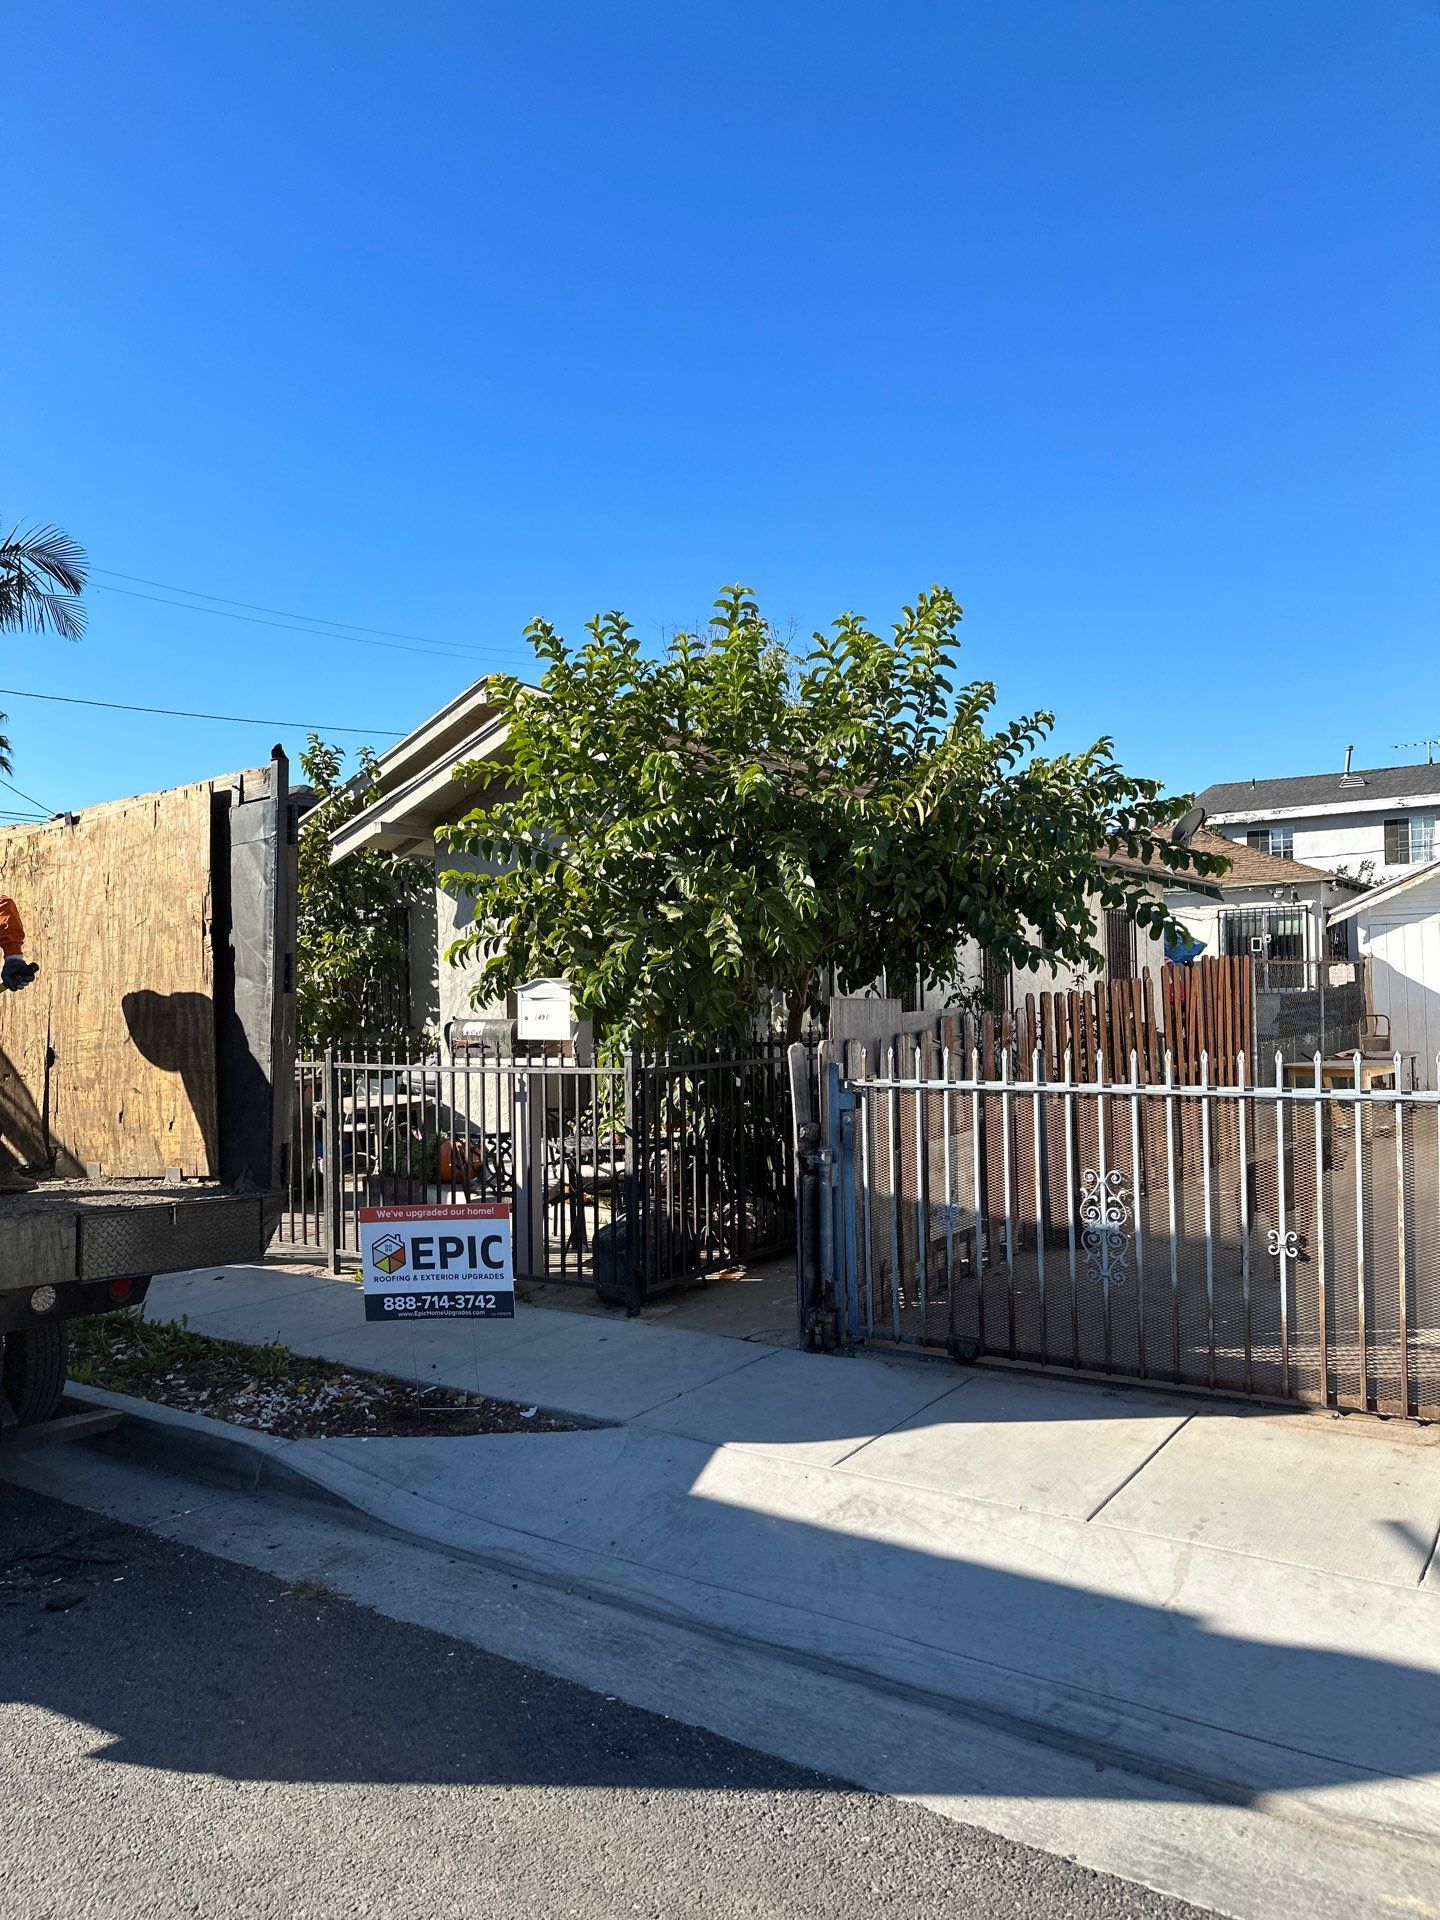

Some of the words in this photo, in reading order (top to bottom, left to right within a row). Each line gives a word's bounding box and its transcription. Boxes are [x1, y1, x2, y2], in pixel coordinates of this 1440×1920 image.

[377, 1210, 404, 1218] We've
[406, 1208, 448, 1218] upgraded
[467, 1207, 494, 1216] home!
[411, 1235, 504, 1270] EPIC
[374, 1275, 411, 1283] ROOFING
[420, 1273, 460, 1281] EXTERIOR
[383, 1294, 496, 1311] 888-714-3742
